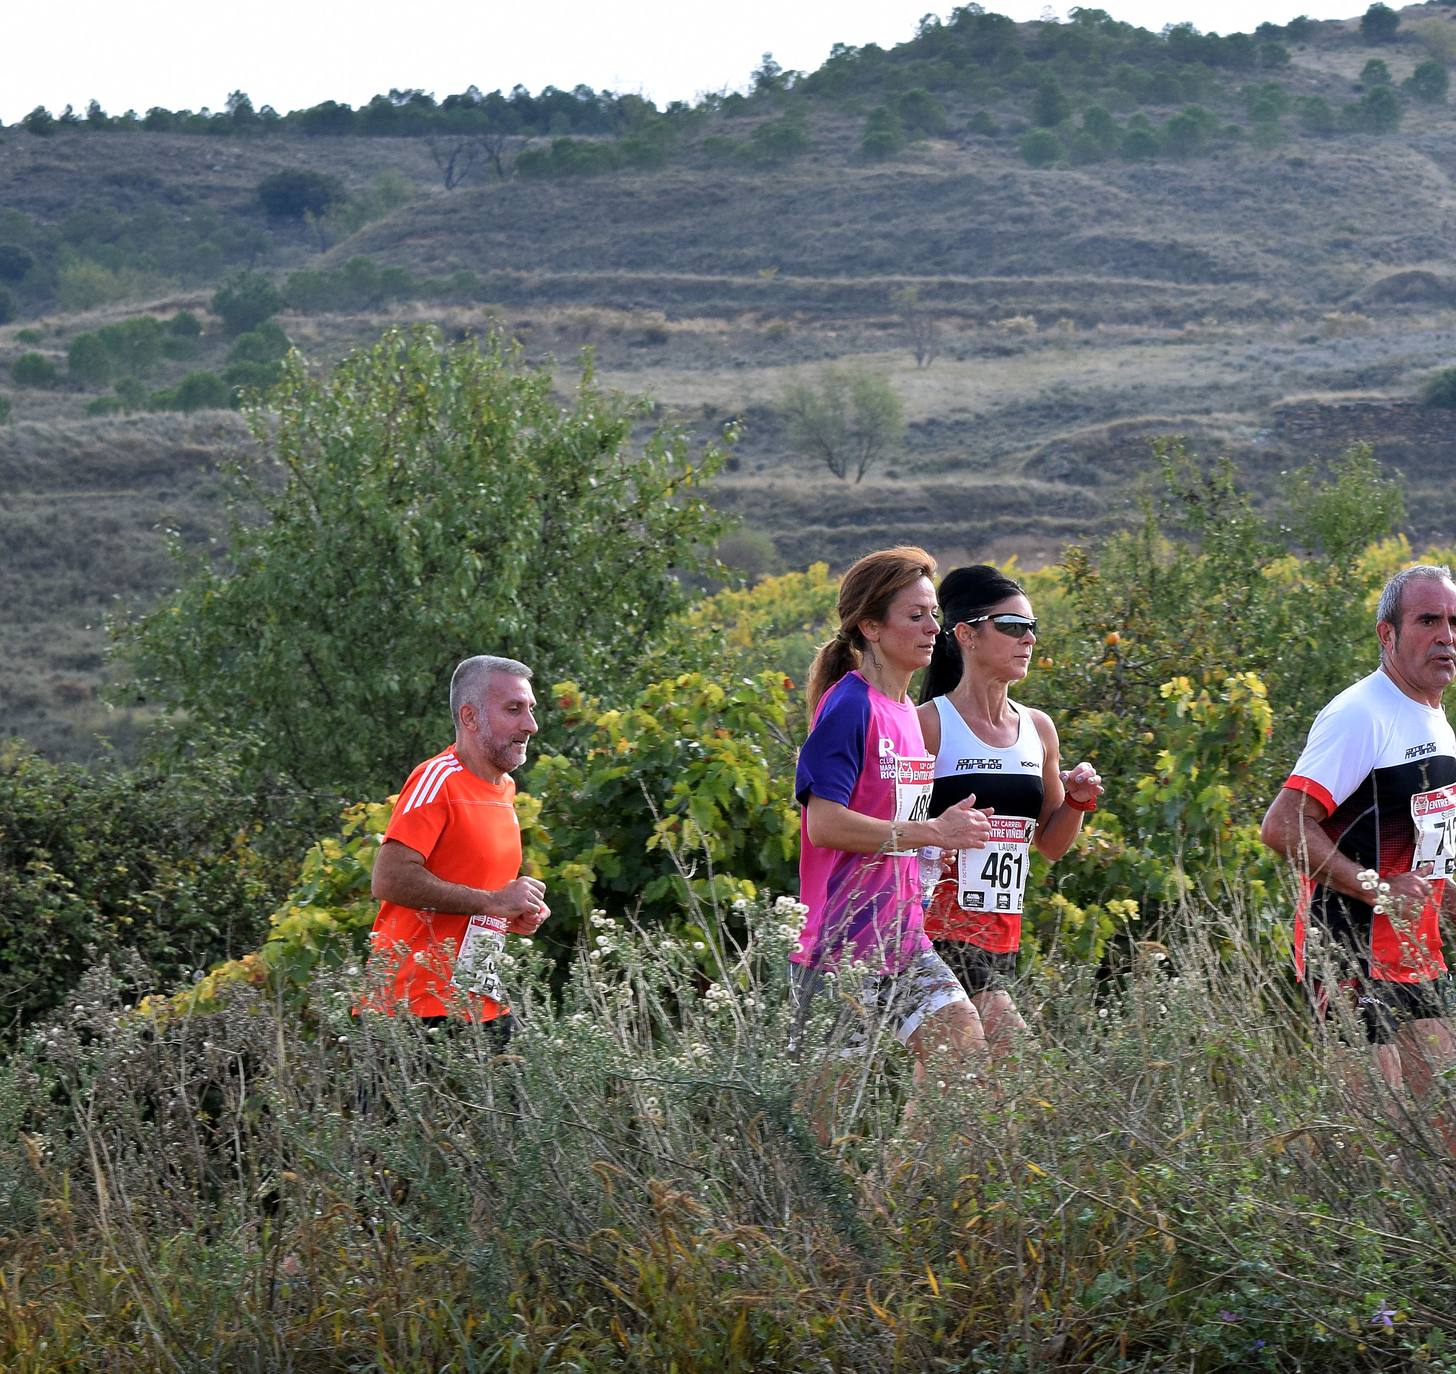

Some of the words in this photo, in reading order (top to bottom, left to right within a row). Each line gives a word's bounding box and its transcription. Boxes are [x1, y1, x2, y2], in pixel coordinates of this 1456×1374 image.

[956, 763, 1002, 771] miranda
[880, 771, 896, 779] RIO
[989, 829, 1006, 838] NTRE
[998, 843, 1018, 852] LAURA
[980, 852, 1022, 889] 461
